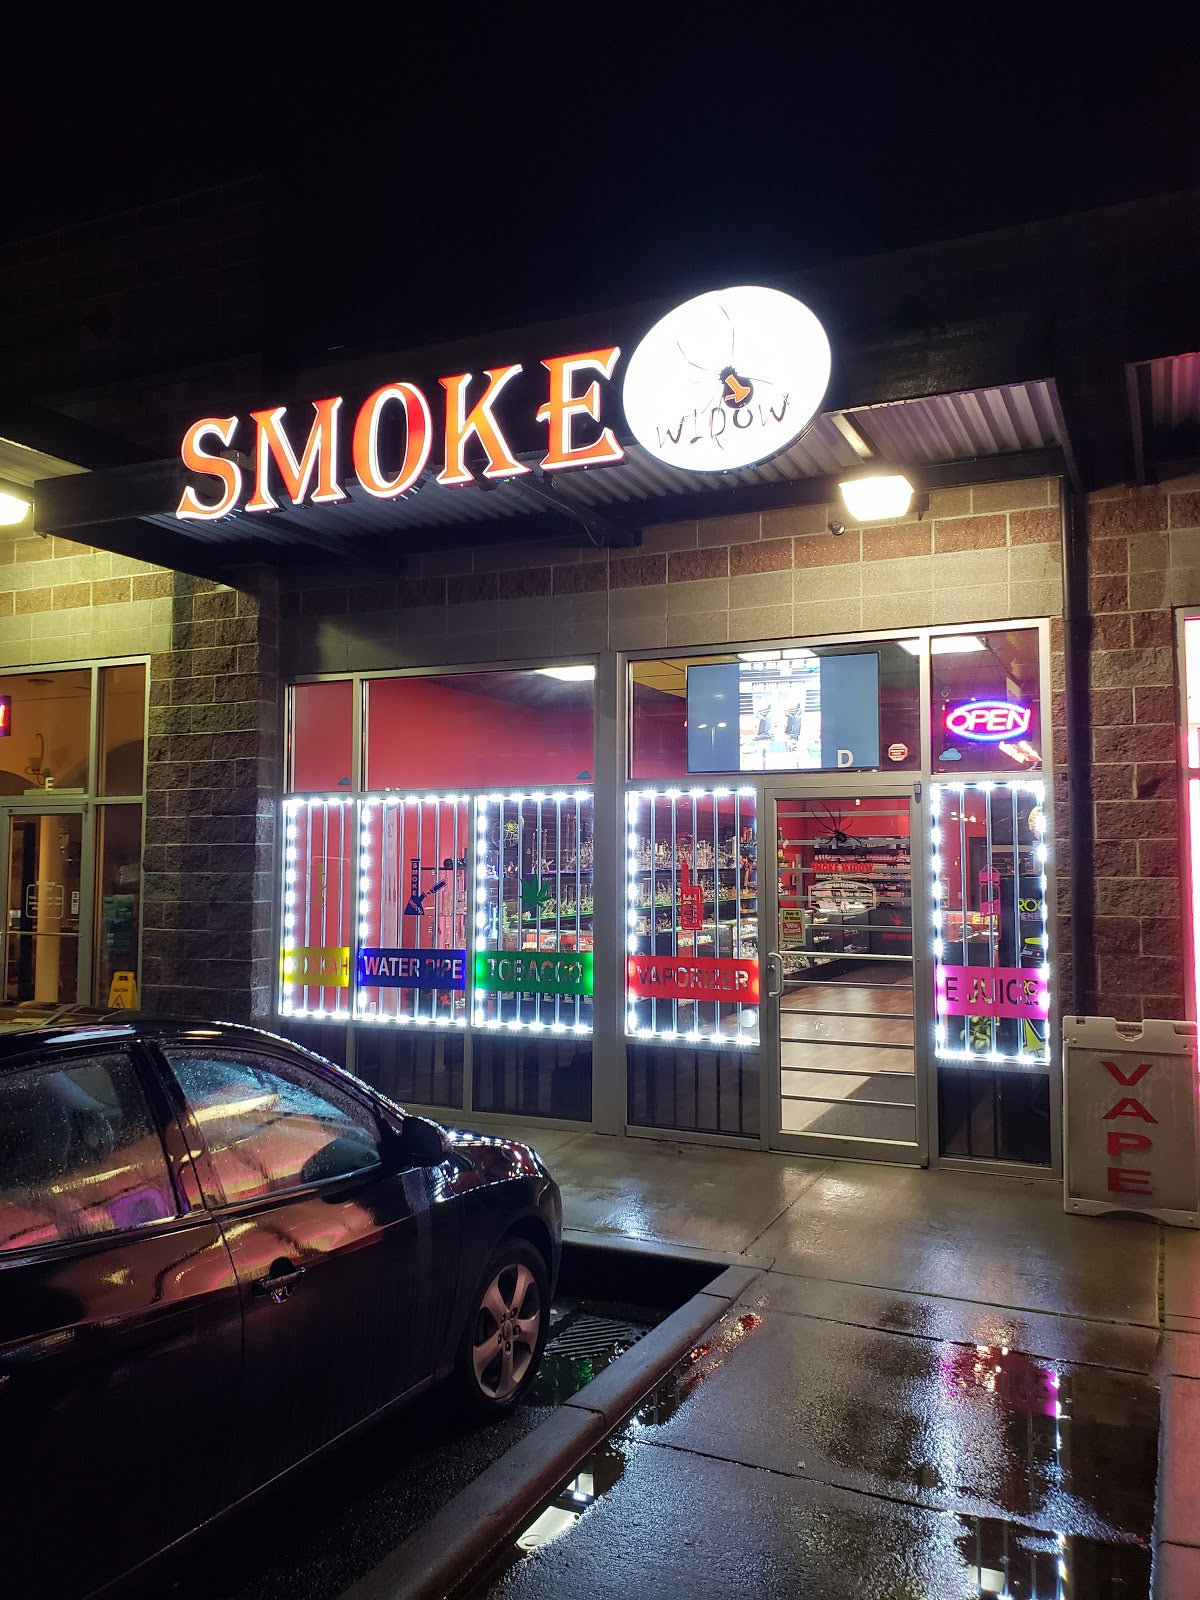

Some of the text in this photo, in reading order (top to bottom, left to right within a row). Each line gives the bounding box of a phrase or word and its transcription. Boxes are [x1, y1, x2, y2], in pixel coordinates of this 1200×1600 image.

[175, 346, 626, 521] SMOKE
[656, 393, 789, 451] WIDOW
[946, 708, 1032, 732] OPEN
[837, 750, 853, 768] D
[45, 777, 54, 791] E
[364, 956, 463, 979] WATER PIPE
[487, 958, 583, 984] TOBACCO
[636, 965, 749, 991] VAPORIZER
[945, 977, 1038, 1005] E JUICE
[1101, 1061, 1159, 1195] VAPE
